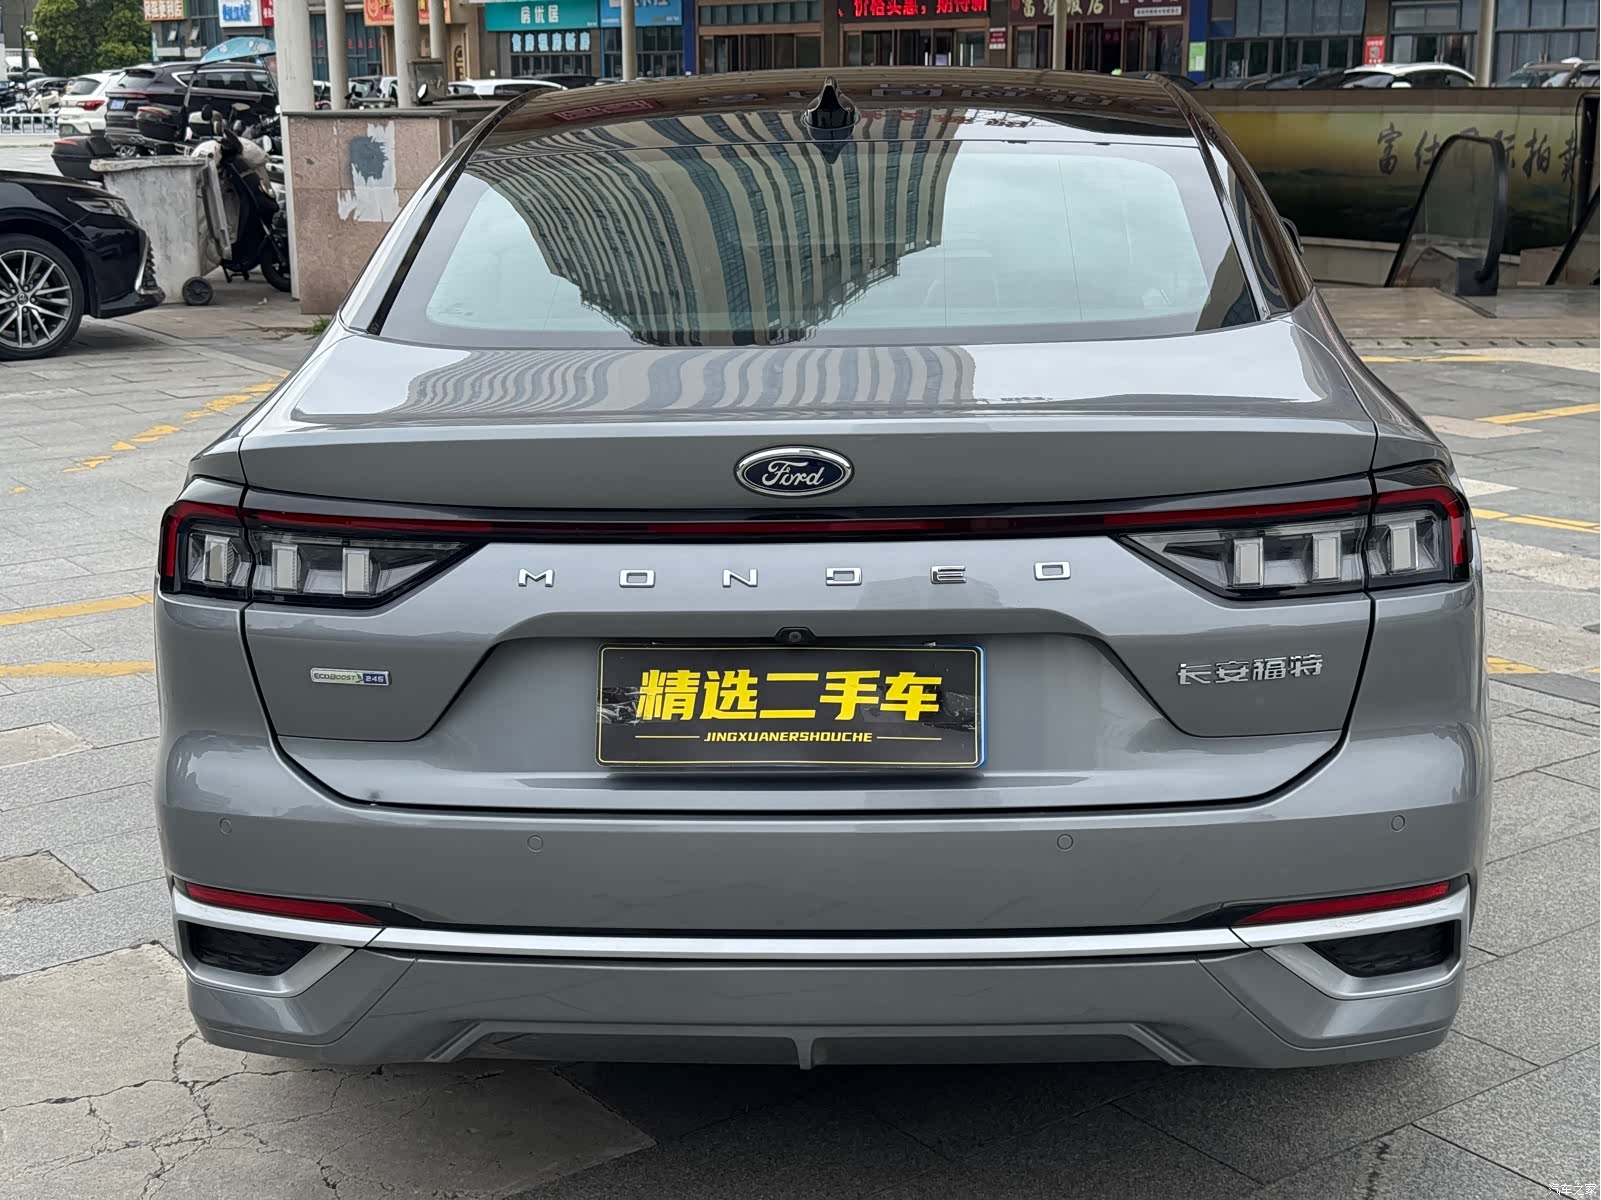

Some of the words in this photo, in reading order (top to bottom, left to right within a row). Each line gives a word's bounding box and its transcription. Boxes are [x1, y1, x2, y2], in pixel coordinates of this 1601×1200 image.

[1377, 122, 1579, 182] 富仕际拍卖
[762, 461, 825, 486] Ford
[518, 560, 1072, 588] MONDEO
[1178, 654, 1323, 685] 长安福特
[635, 669, 943, 721] 精选二手车
[704, 731, 873, 743] JINGXUANERSHOUCHE
